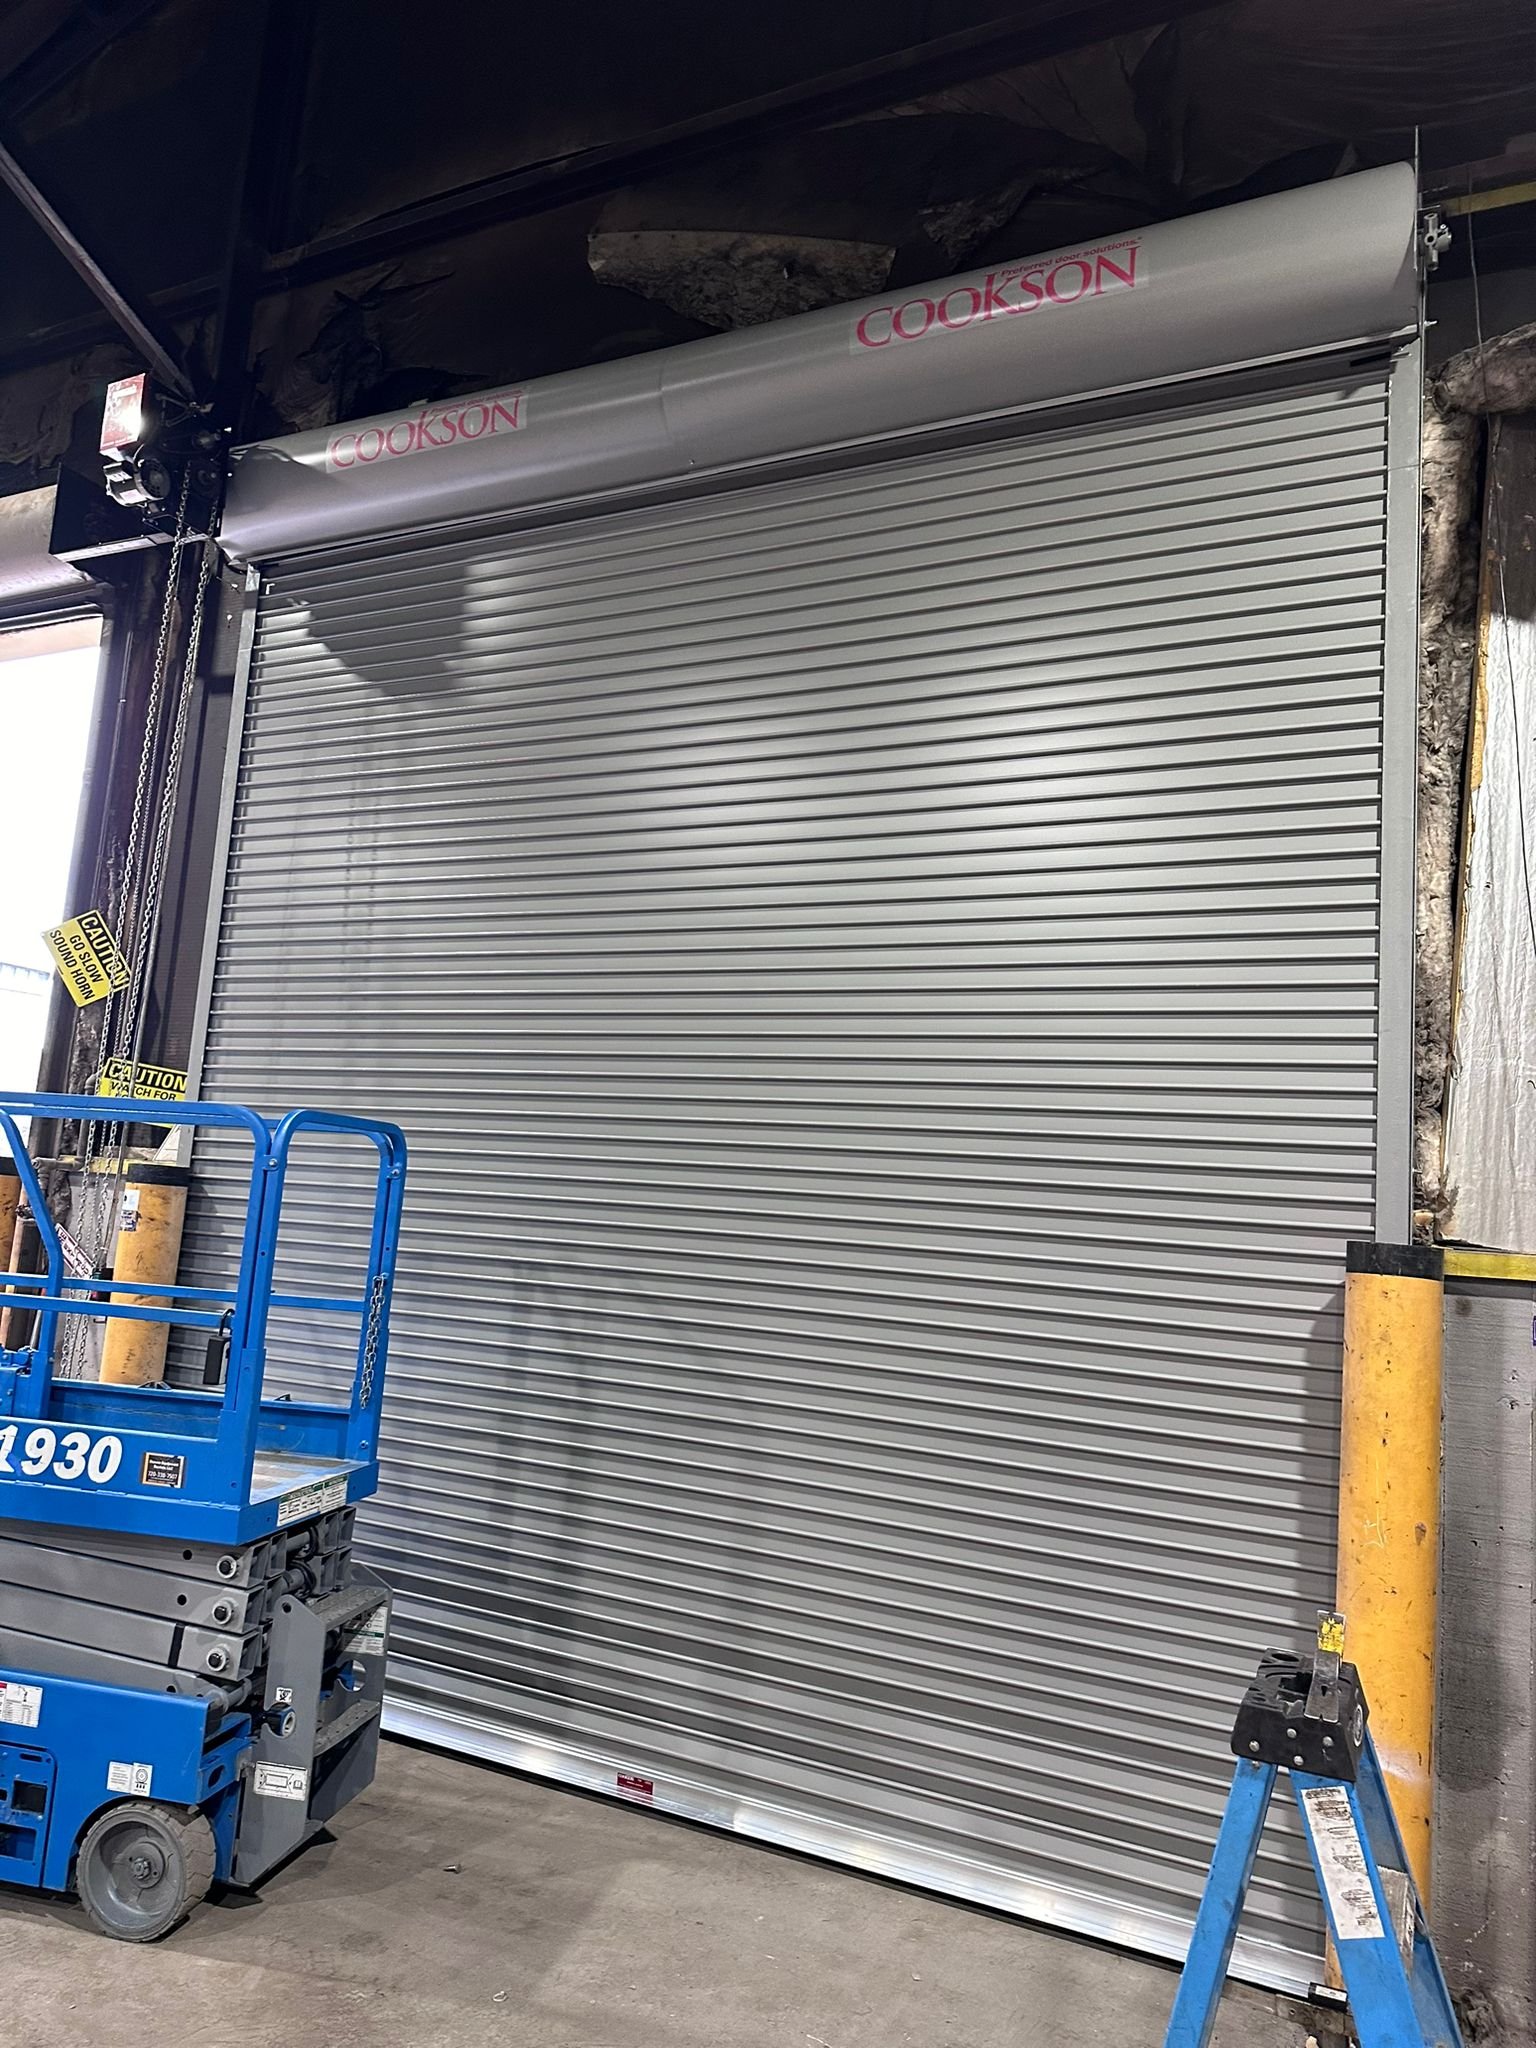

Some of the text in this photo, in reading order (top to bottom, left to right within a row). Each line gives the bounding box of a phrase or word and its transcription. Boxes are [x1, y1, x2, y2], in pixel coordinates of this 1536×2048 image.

[1055, 252, 1081, 264] door
[856, 246, 1141, 348] COOKSON
[331, 394, 525, 468] COOKSON
[50, 930, 96, 1000] SOUND HORN
[69, 934, 104, 983] GO SLOW
[81, 916, 130, 989] CAUTION
[108, 1063, 187, 1091] CAUTION
[111, 1081, 152, 1097] WACH
[153, 1091, 177, 1101] FOR
